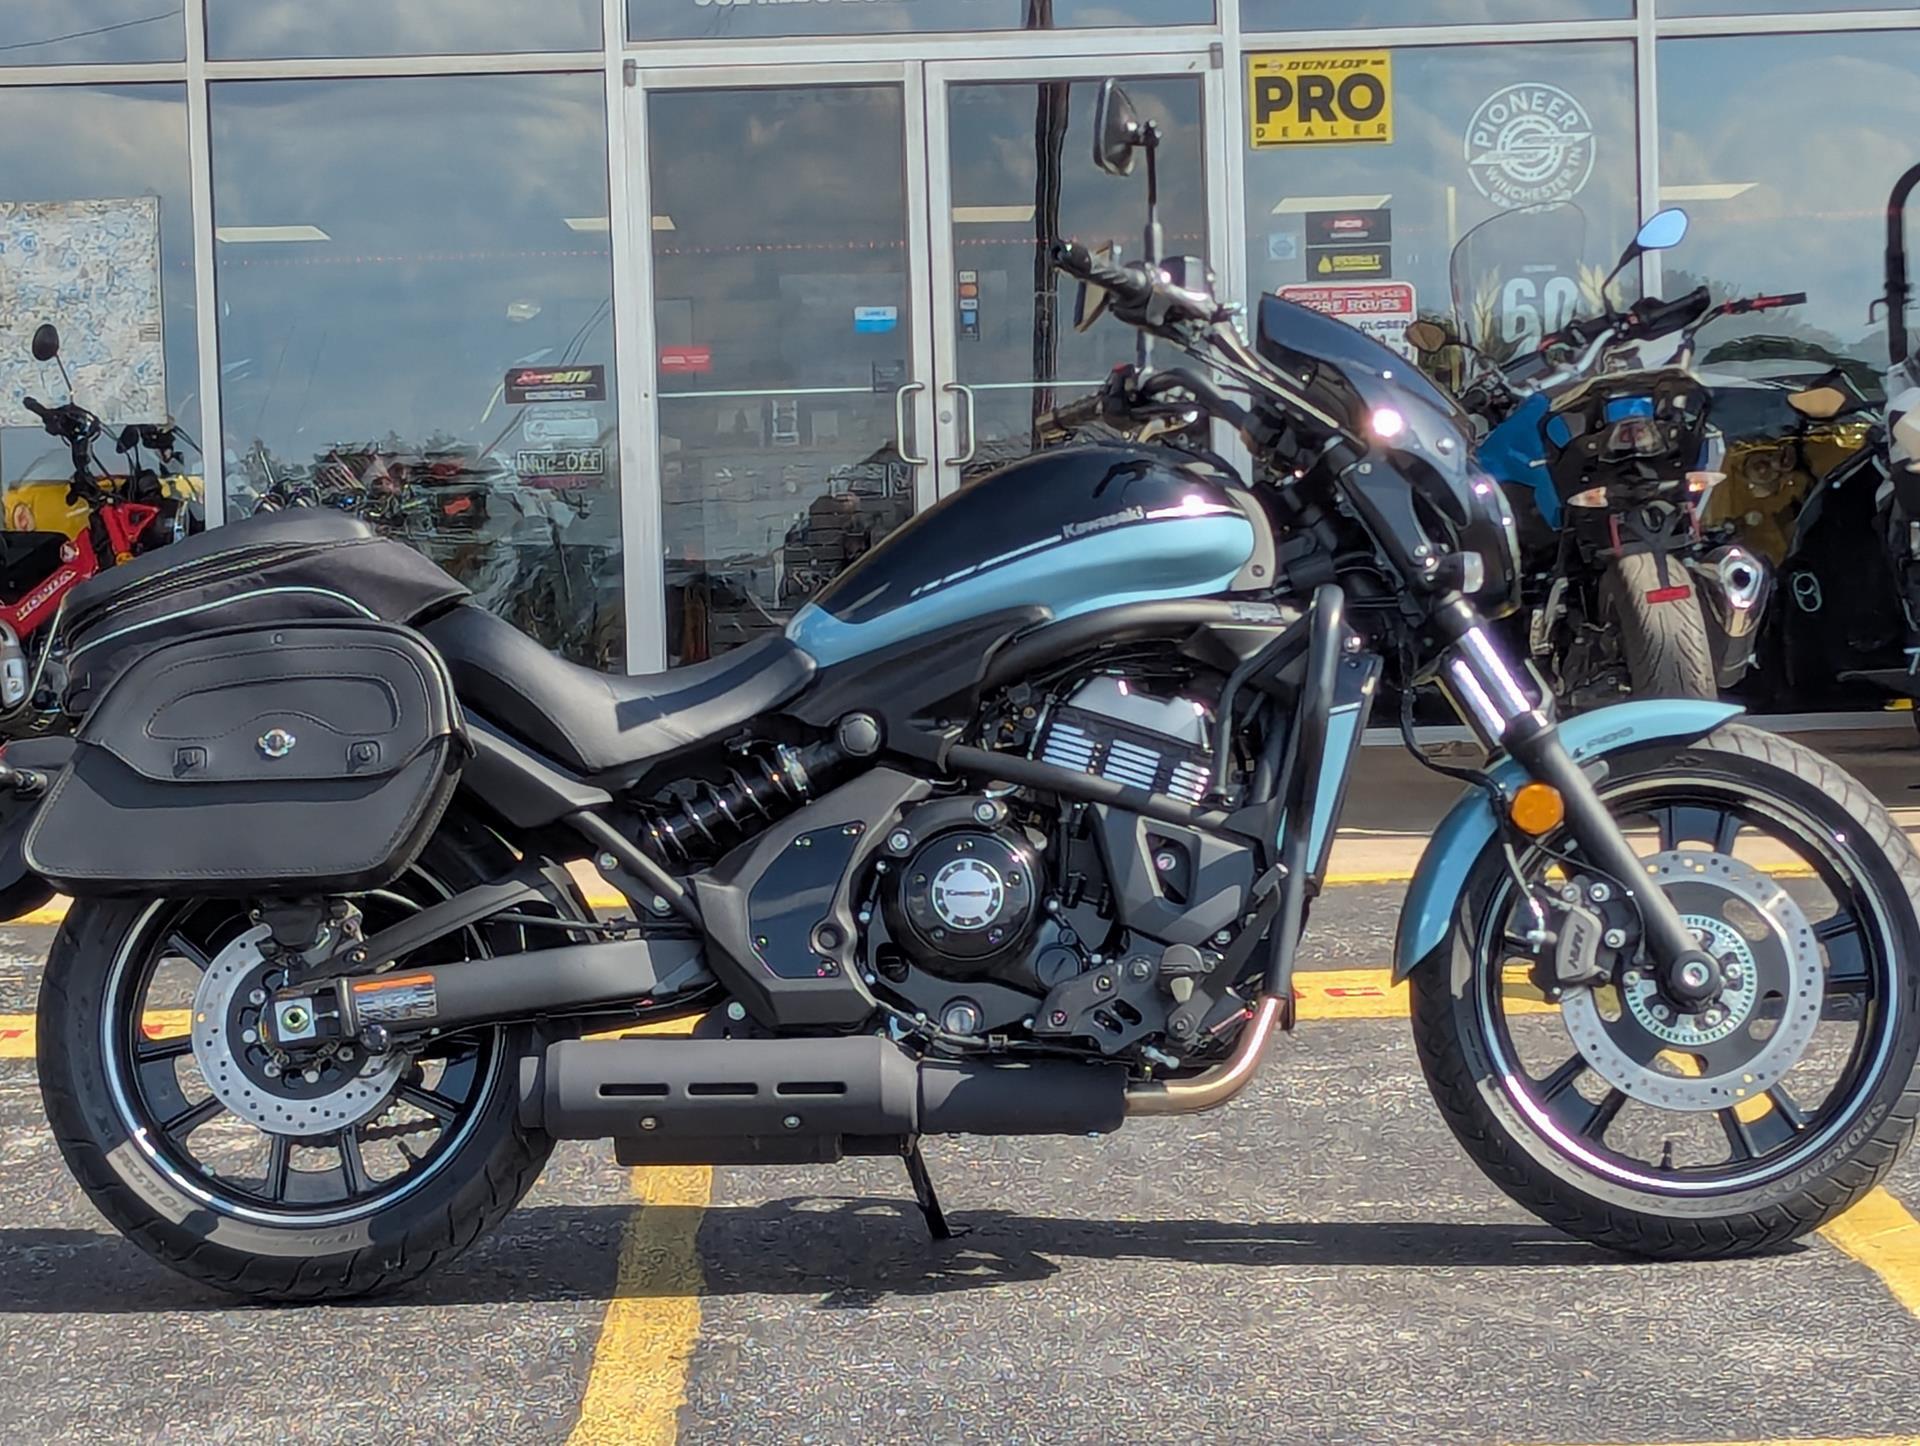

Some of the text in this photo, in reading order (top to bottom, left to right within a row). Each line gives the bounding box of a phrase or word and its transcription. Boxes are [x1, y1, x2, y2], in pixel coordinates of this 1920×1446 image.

[1285, 59, 1369, 71] DUNLOP
[1254, 72, 1386, 125] PRO
[1473, 90, 1579, 148] PIONEER
[1256, 122, 1387, 139] DEALER
[1502, 276, 1579, 345] 60
